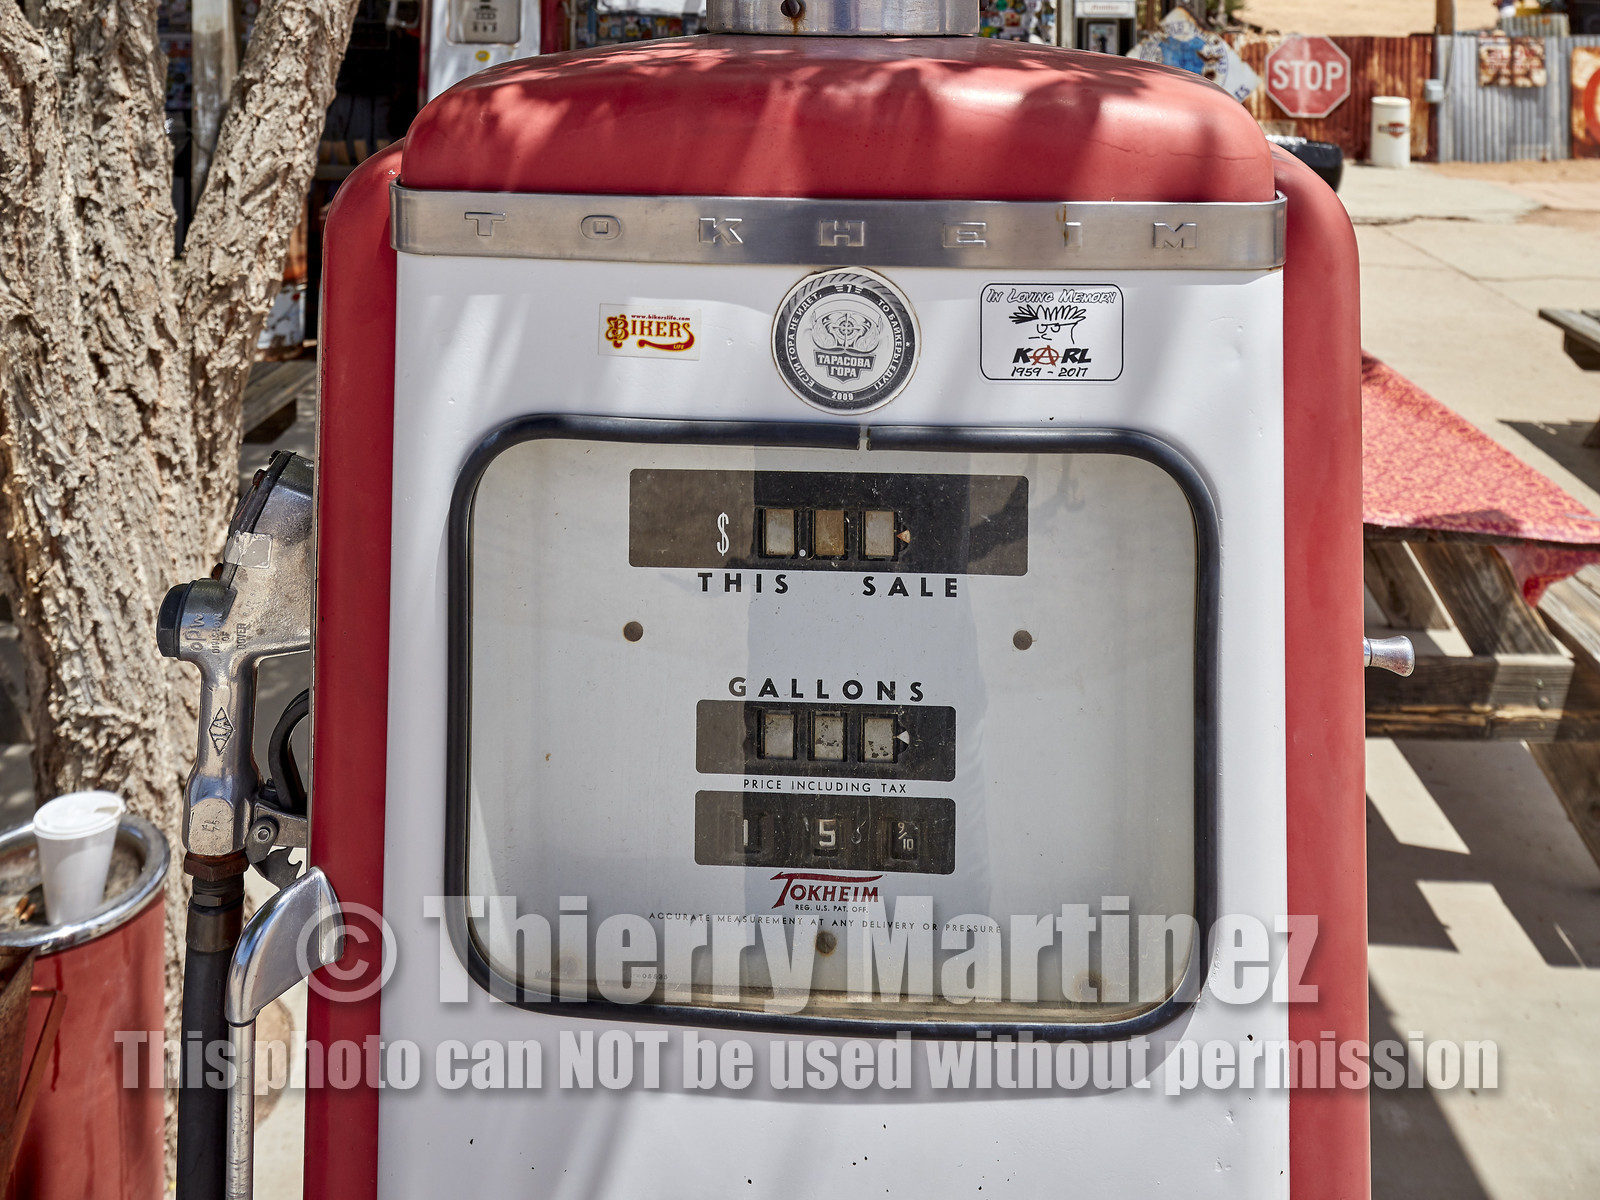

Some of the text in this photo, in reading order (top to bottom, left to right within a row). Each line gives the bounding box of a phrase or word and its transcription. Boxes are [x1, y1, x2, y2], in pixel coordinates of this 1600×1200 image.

[1271, 60, 1344, 91] STOP
[464, 211, 1198, 250] TOKHEIM
[986, 288, 1117, 303] IN LOVING MEMORY
[605, 314, 695, 351] BIKERS
[788, 315, 799, 332] НЕ
[877, 299, 890, 313] ТО
[888, 313, 903, 364] БАЙКЕРЫ
[788, 332, 797, 361] ГОРА
[1012, 345, 1092, 367] KARL
[818, 354, 871, 368] ТАРАСОВА
[830, 366, 857, 377] ГОРА
[1011, 366, 1042, 377] 1959
[1058, 366, 1088, 377] 2017
[792, 360, 815, 388] ЕСЛИ
[831, 391, 854, 401] 2009
[717, 512, 729, 556] $
[698, 572, 958, 597] THIS SALE
[236, 623, 246, 649] DOVER
[728, 677, 923, 702] GALLONS
[743, 779, 906, 793] PRICE INCLUDING TAX
[819, 819, 836, 847] 5
[770, 872, 883, 909] TOKHEIM
[649, 912, 710, 922] ACCURATE
[717, 914, 803, 925] MEASUREMENT
[832, 919, 854, 927] ANY
[862, 921, 915, 930] DELIVERY
[923, 923, 937, 931] OR
[946, 924, 1000, 933] PRESSURE
